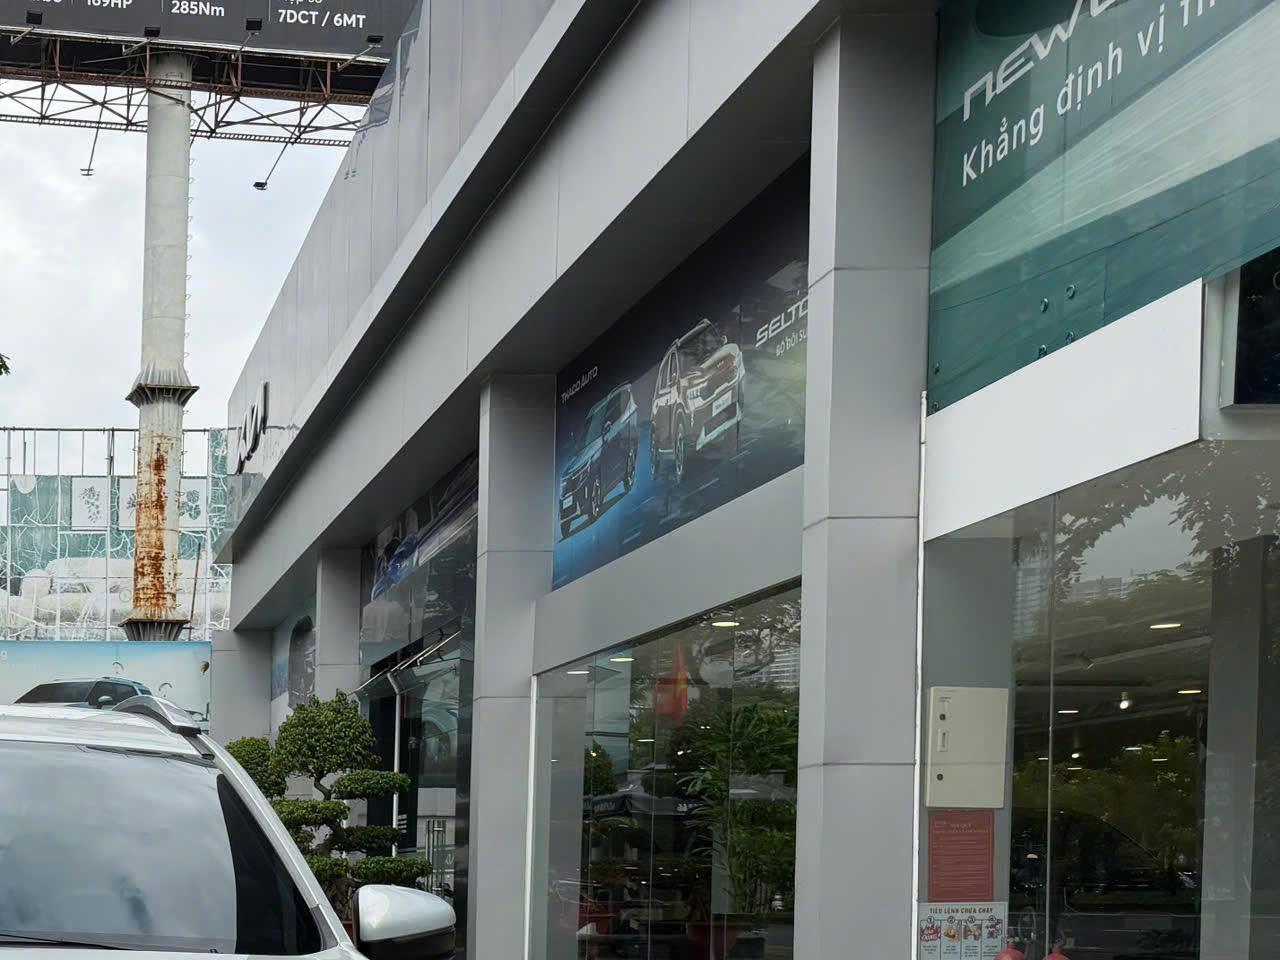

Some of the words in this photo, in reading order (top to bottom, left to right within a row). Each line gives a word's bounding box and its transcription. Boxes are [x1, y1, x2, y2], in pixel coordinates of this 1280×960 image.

[171, 1, 225, 17] 285Nm
[278, 9, 319, 25] 7DCT
[333, 13, 367, 28] 6MT
[962, 103, 1045, 187] Khẳng
[1056, 41, 1123, 115] định
[1137, 4, 1165, 56] vị
